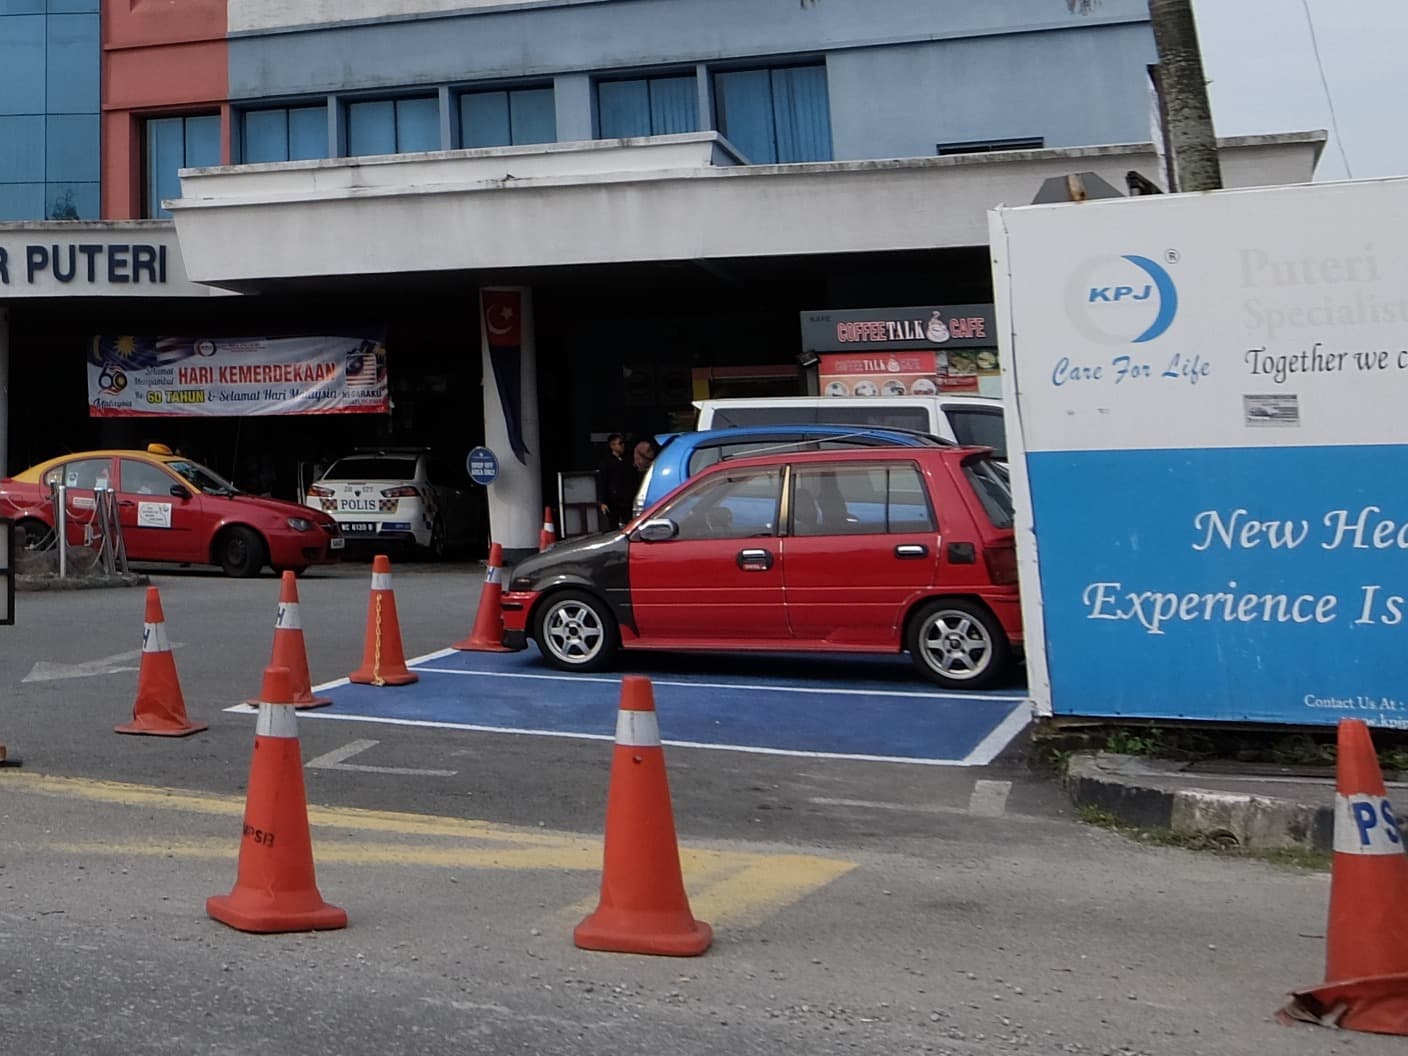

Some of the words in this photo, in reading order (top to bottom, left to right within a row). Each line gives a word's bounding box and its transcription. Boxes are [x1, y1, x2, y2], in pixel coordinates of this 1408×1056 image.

[26, 244, 168, 284] PUTERI
[1240, 243, 1382, 288] Puteri
[1089, 285, 1152, 302] KPJ
[837, 321, 887, 342] COFFEE
[887, 320, 926, 340] TALK
[949, 317, 986, 339] CAFE
[179, 366, 214, 384] HARI
[219, 363, 336, 384] KEMERDEKAAN
[1052, 357, 1104, 386] Care
[1112, 355, 1151, 384] For
[1162, 352, 1210, 384] Life
[1244, 343, 1349, 384] Together
[1353, 351, 1389, 371] we
[165, 390, 205, 403] TAHUN
[219, 390, 260, 401] Selamat
[263, 389, 286, 400] Hari
[341, 499, 376, 510] POLIS
[1192, 509, 1309, 550] New
[1082, 581, 1337, 634] Experience
[1355, 585, 1405, 625] Is
[1304, 694, 1355, 709] Contact
[1357, 696, 1377, 710] Us
[1379, 698, 1397, 711] At
